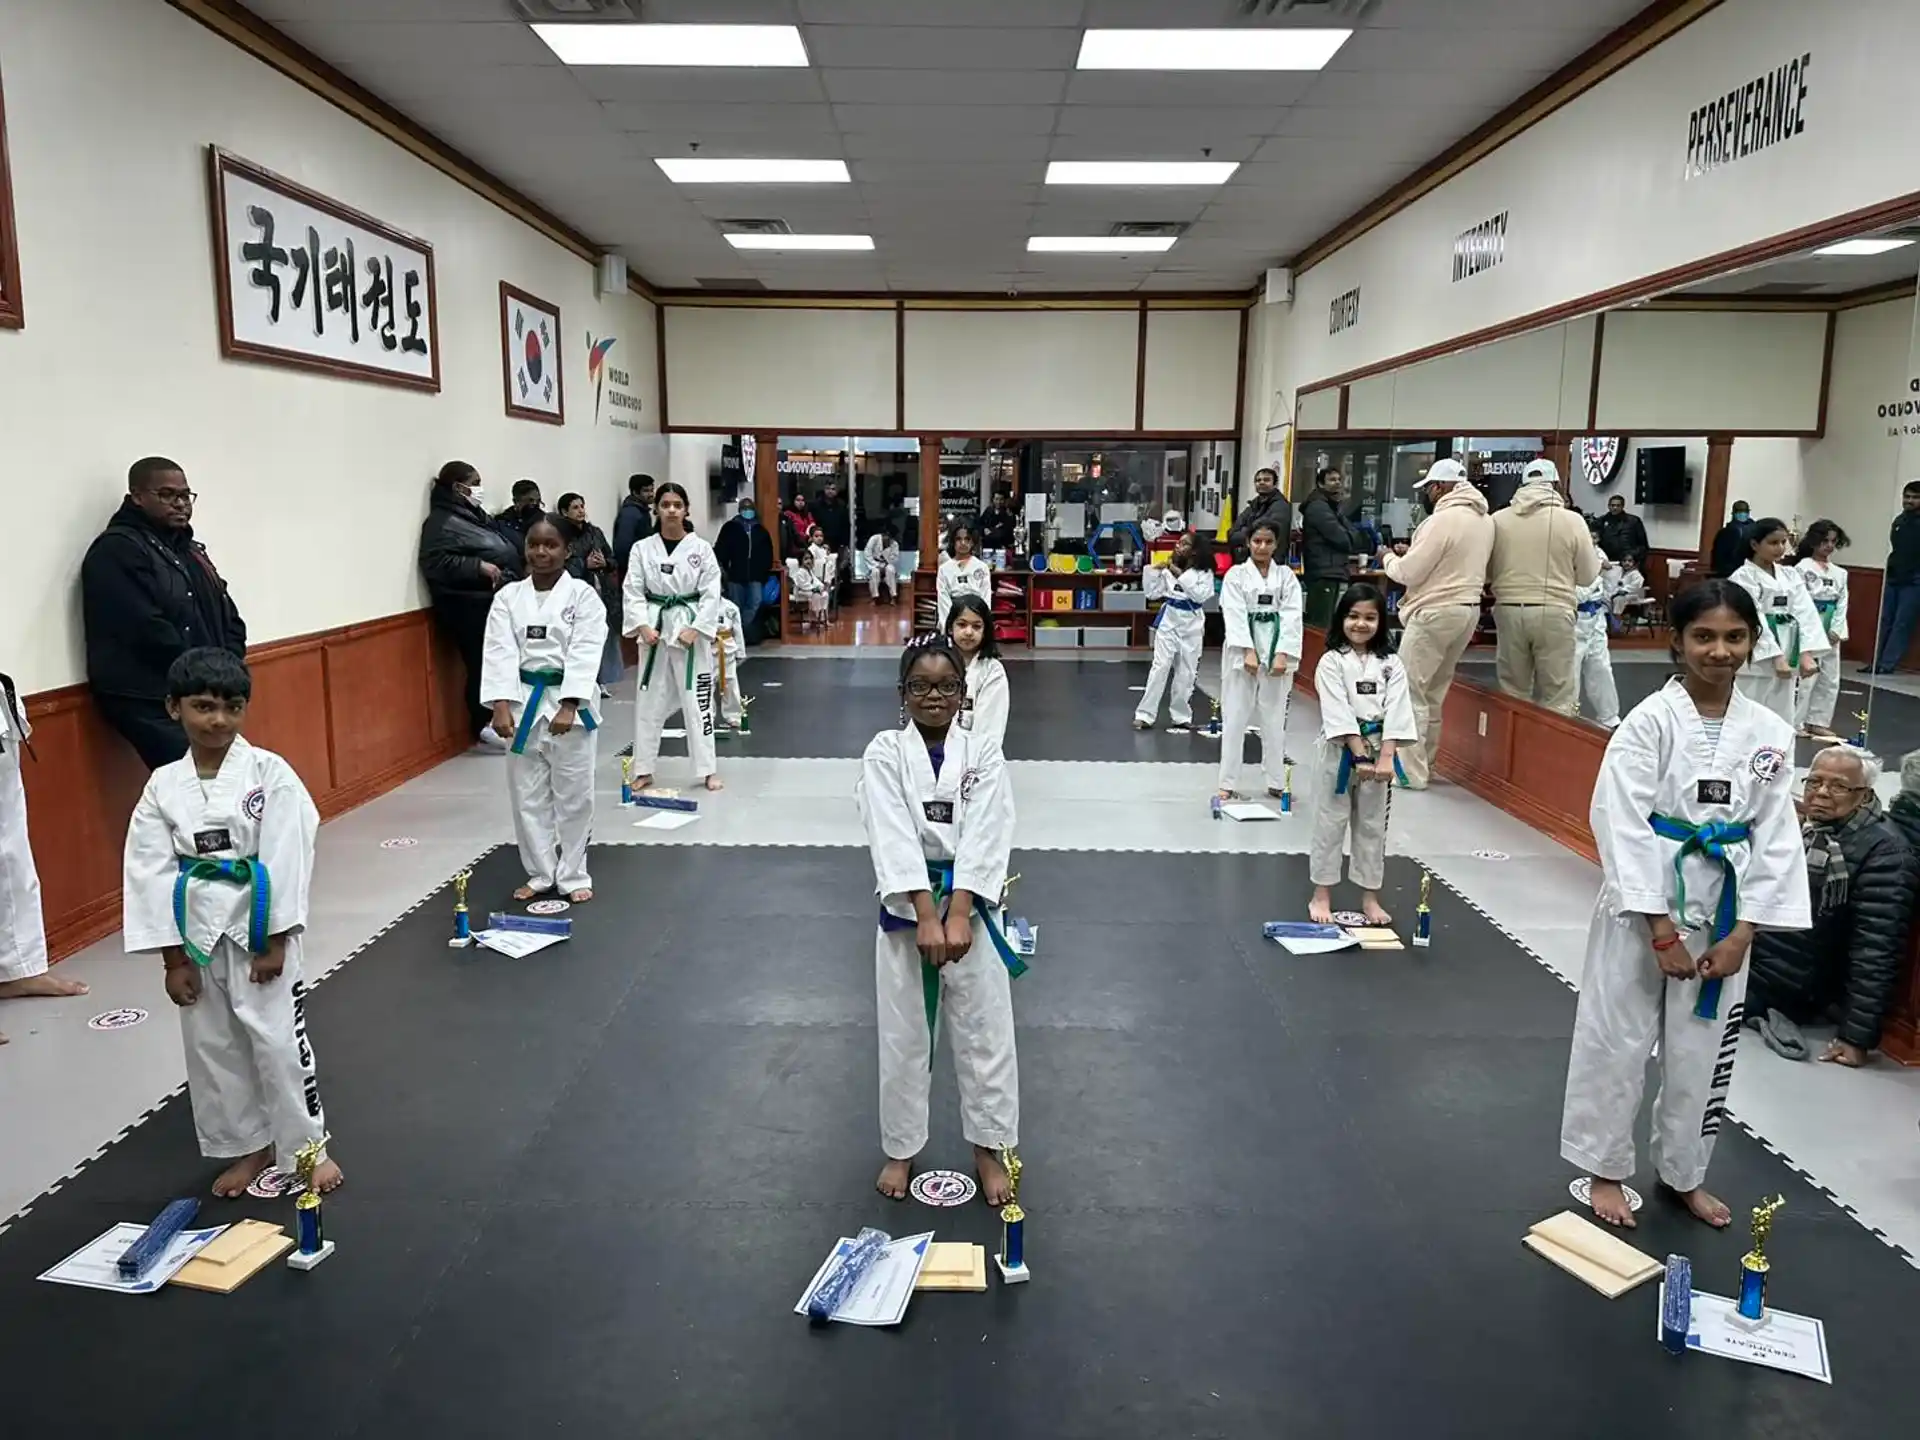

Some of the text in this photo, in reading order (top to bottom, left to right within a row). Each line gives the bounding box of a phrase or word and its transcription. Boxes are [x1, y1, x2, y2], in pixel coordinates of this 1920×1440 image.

[1685, 53, 1811, 181] PERSEVERANCE
[1452, 211, 1509, 283] INTEGRITY
[696, 673, 713, 736] UNITED TKD
